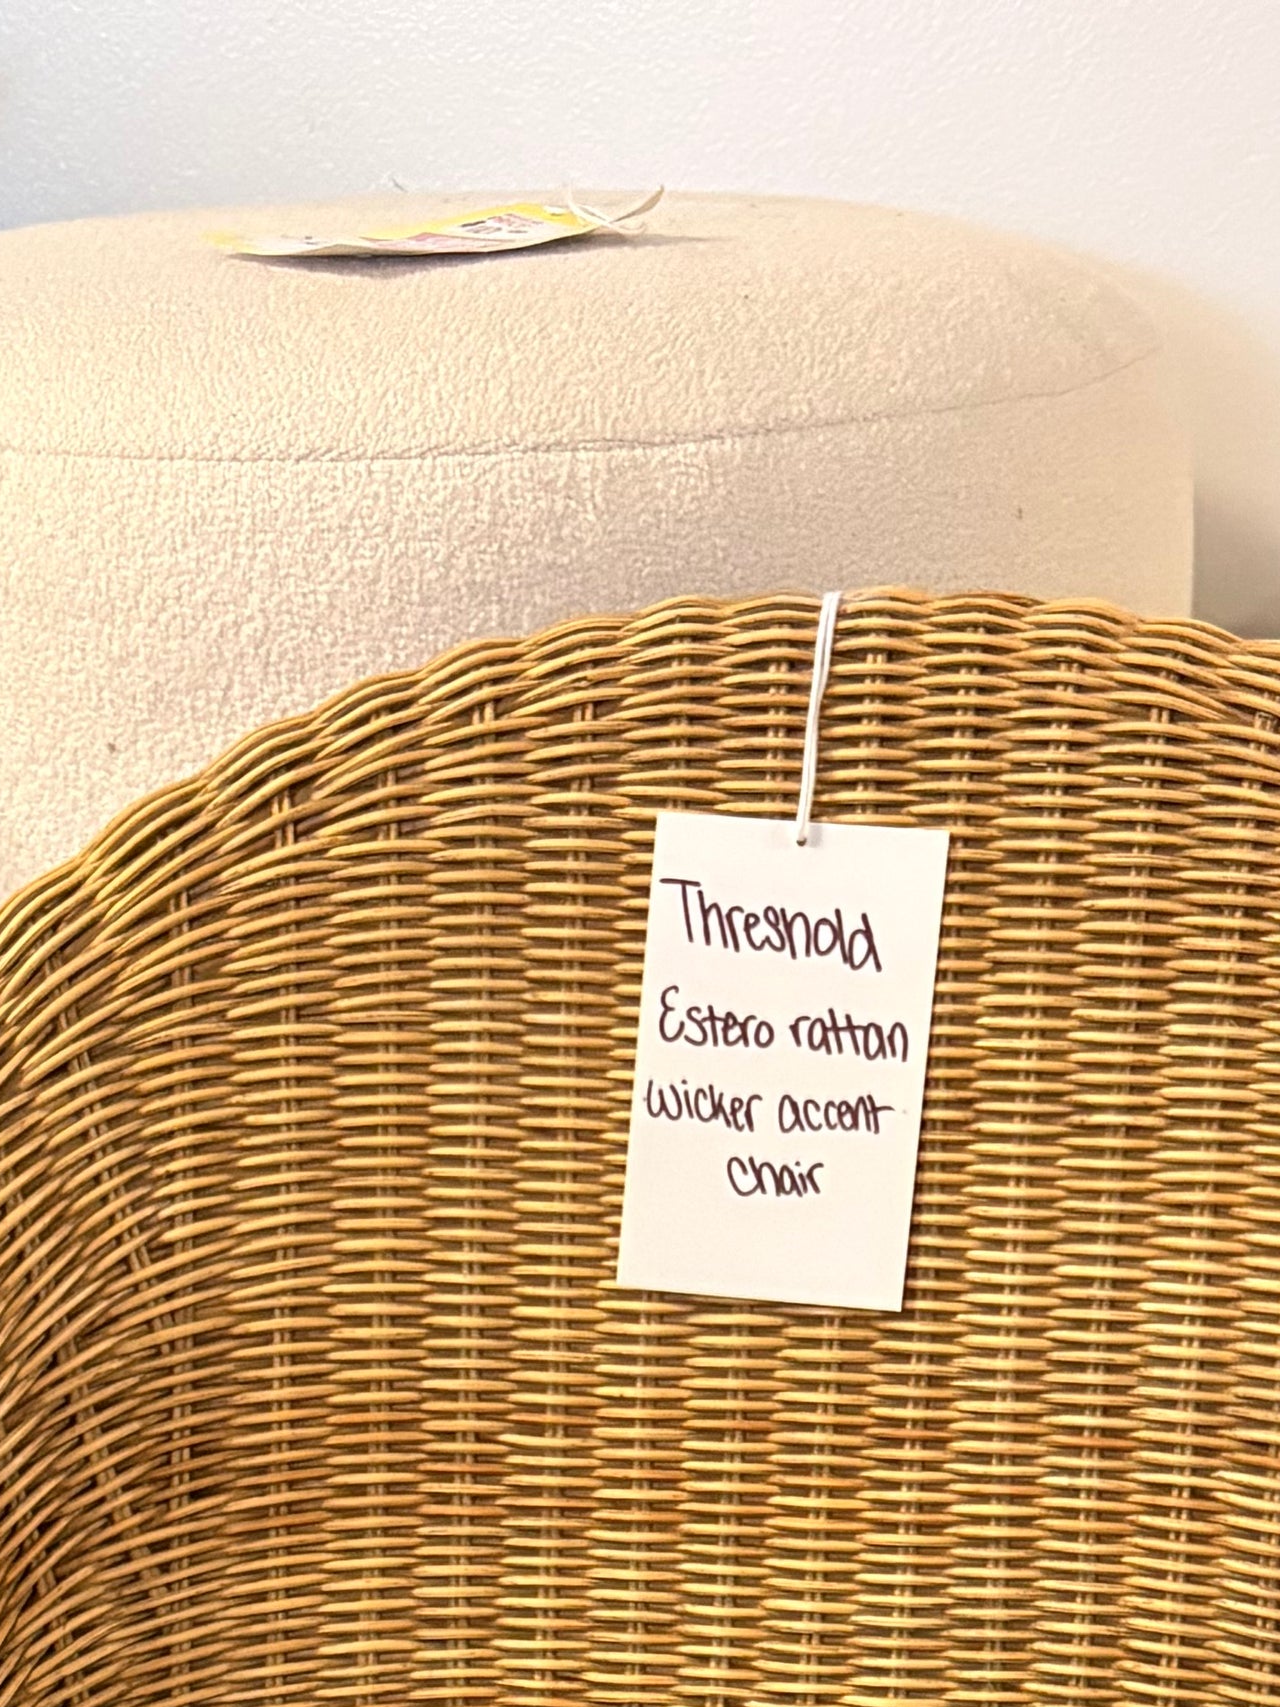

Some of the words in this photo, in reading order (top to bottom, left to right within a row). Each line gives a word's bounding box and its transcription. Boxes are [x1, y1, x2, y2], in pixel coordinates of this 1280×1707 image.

[659, 877, 883, 973] Threshold
[658, 984, 775, 1049] Estero
[788, 1007, 909, 1063] rattan
[778, 1094, 896, 1135] accent
